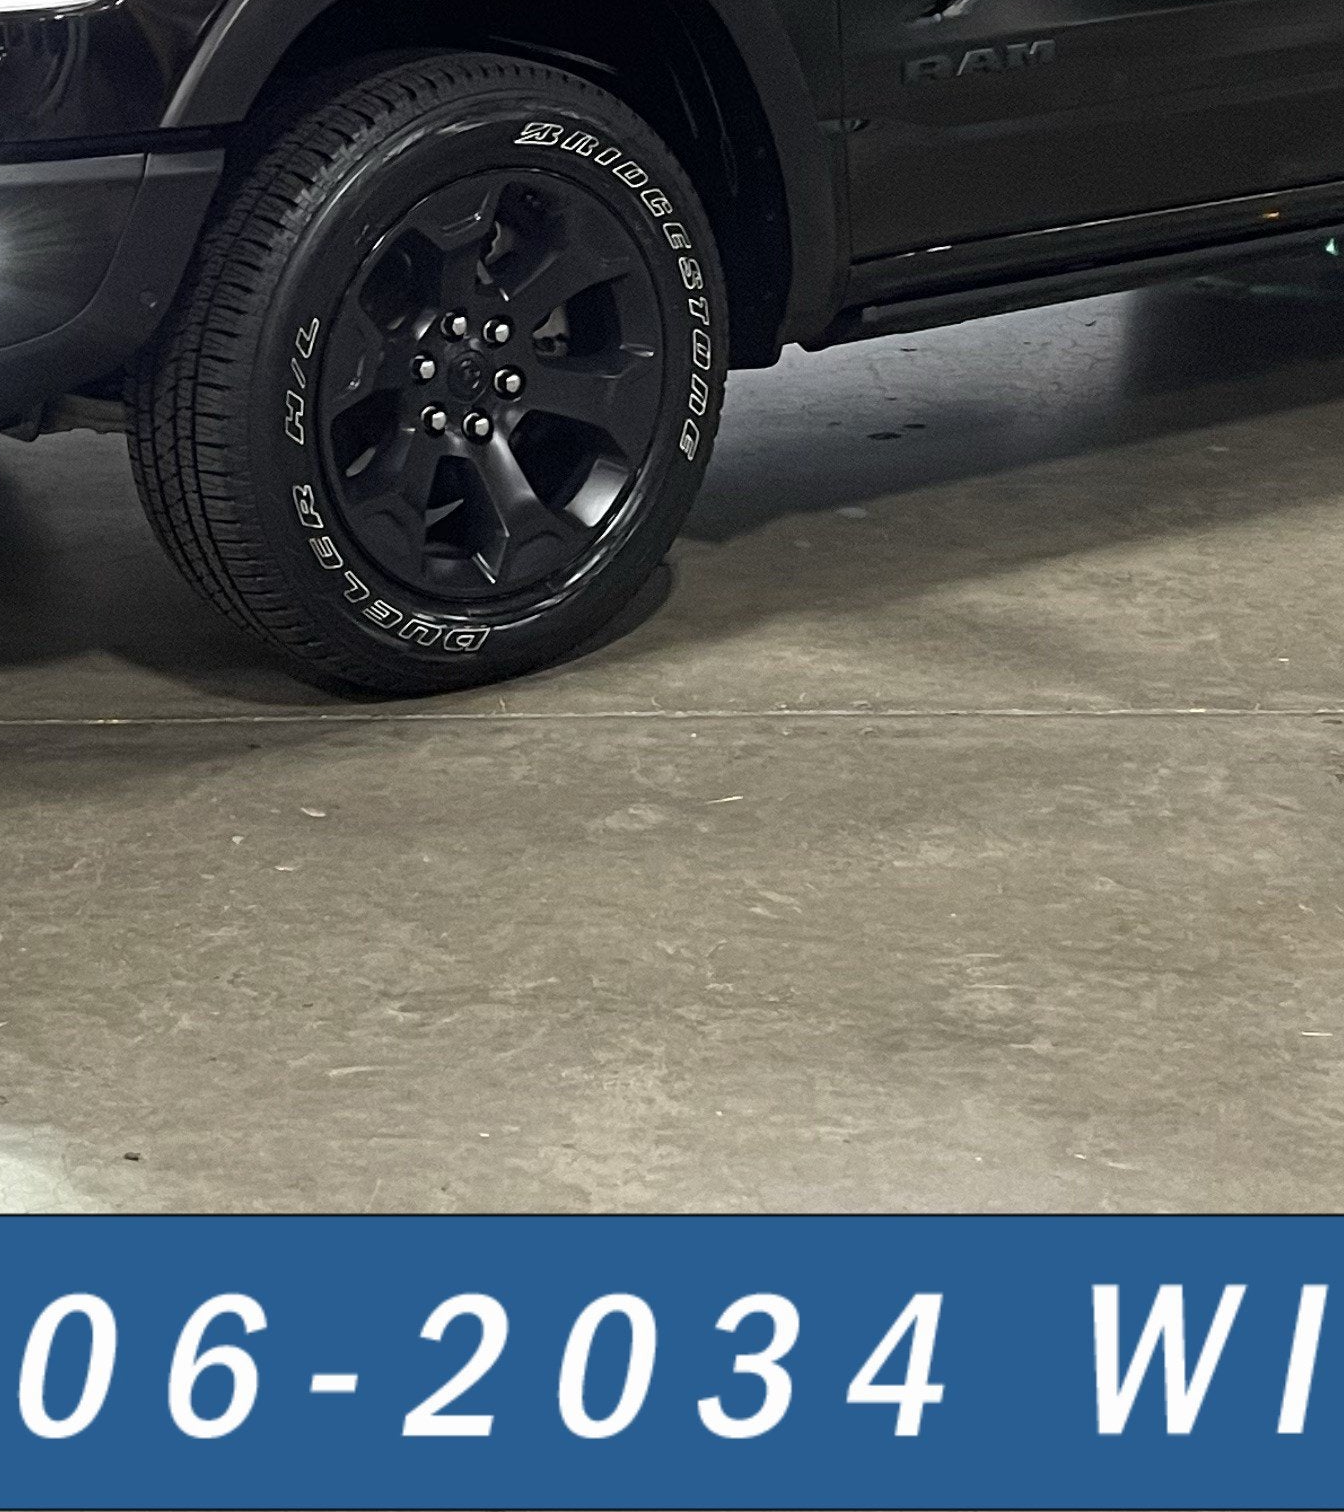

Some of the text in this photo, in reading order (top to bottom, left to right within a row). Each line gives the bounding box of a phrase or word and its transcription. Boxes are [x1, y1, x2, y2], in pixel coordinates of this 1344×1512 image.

[901, 38, 1057, 88] RAM
[514, 121, 710, 462] BRIDGESTONE
[283, 316, 492, 653] DUELER H/L
